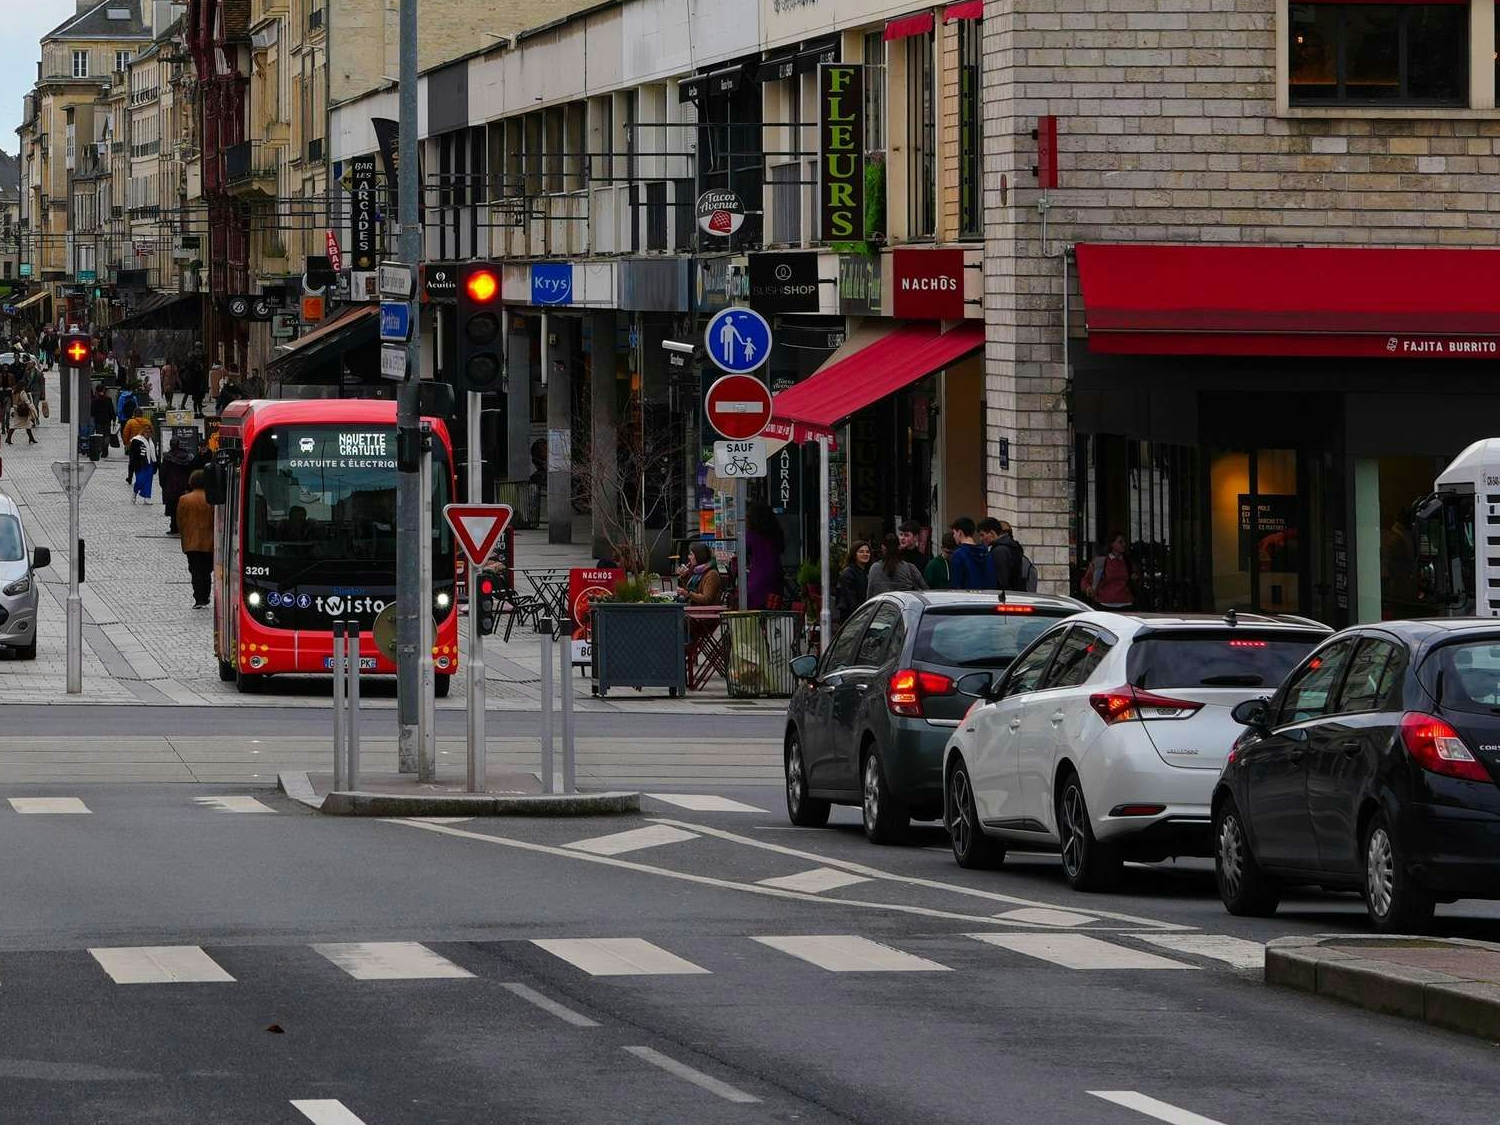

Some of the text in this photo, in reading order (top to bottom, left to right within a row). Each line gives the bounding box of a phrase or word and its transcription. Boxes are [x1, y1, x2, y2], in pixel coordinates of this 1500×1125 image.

[825, 68, 858, 237] FLEURS
[354, 162, 373, 170] BAR
[705, 192, 736, 203] Tacos
[700, 200, 739, 213] Avenue
[357, 181, 370, 251] ARCADES
[327, 230, 341, 271] TABAC
[534, 277, 567, 293] Krys
[1403, 341, 1496, 352] FAJITA BURRITO
[339, 433, 386, 445] NAVETTE
[339, 445, 386, 456] GRATUITE
[726, 443, 754, 453] SAUF
[290, 460, 338, 468] GRATUITE
[340, 460, 347, 468] &
[779, 449, 790, 509] AURANT
[245, 566, 270, 575] 3201
[582, 571, 613, 580] NACHOS
